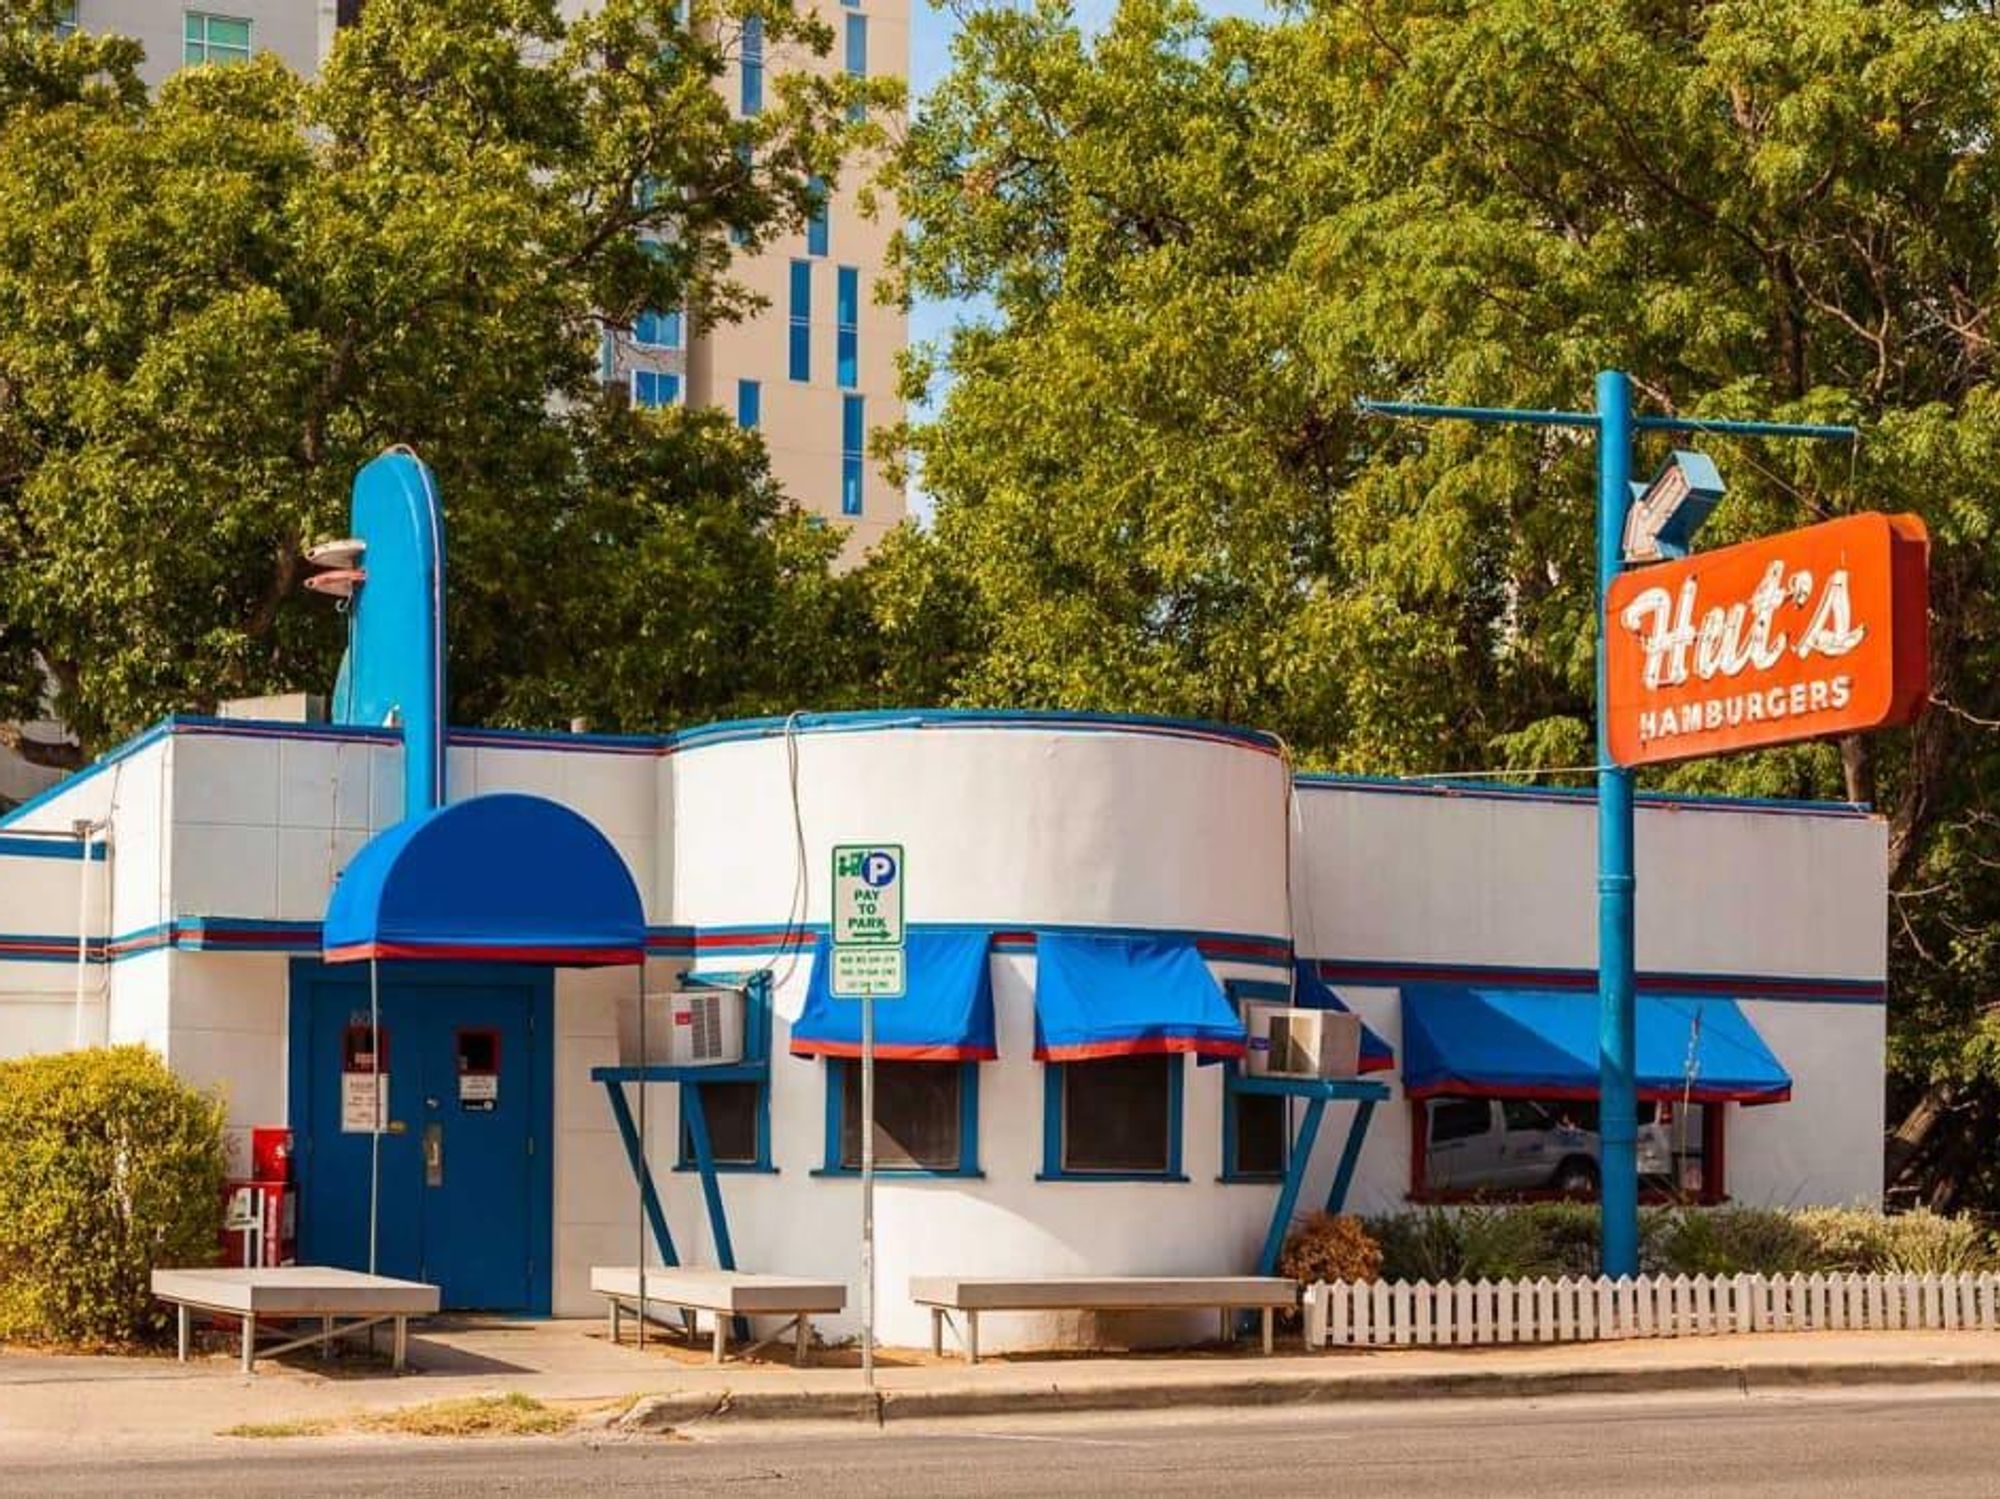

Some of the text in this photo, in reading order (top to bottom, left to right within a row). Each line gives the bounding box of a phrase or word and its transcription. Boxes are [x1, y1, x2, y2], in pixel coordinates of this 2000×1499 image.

[1621, 559, 1866, 691] Hut's
[1640, 676, 1852, 740] HAMBURGERS
[870, 857, 891, 884] P
[855, 888, 880, 901] PAY
[858, 904, 877, 915] TO
[848, 918, 887, 930] PARK
